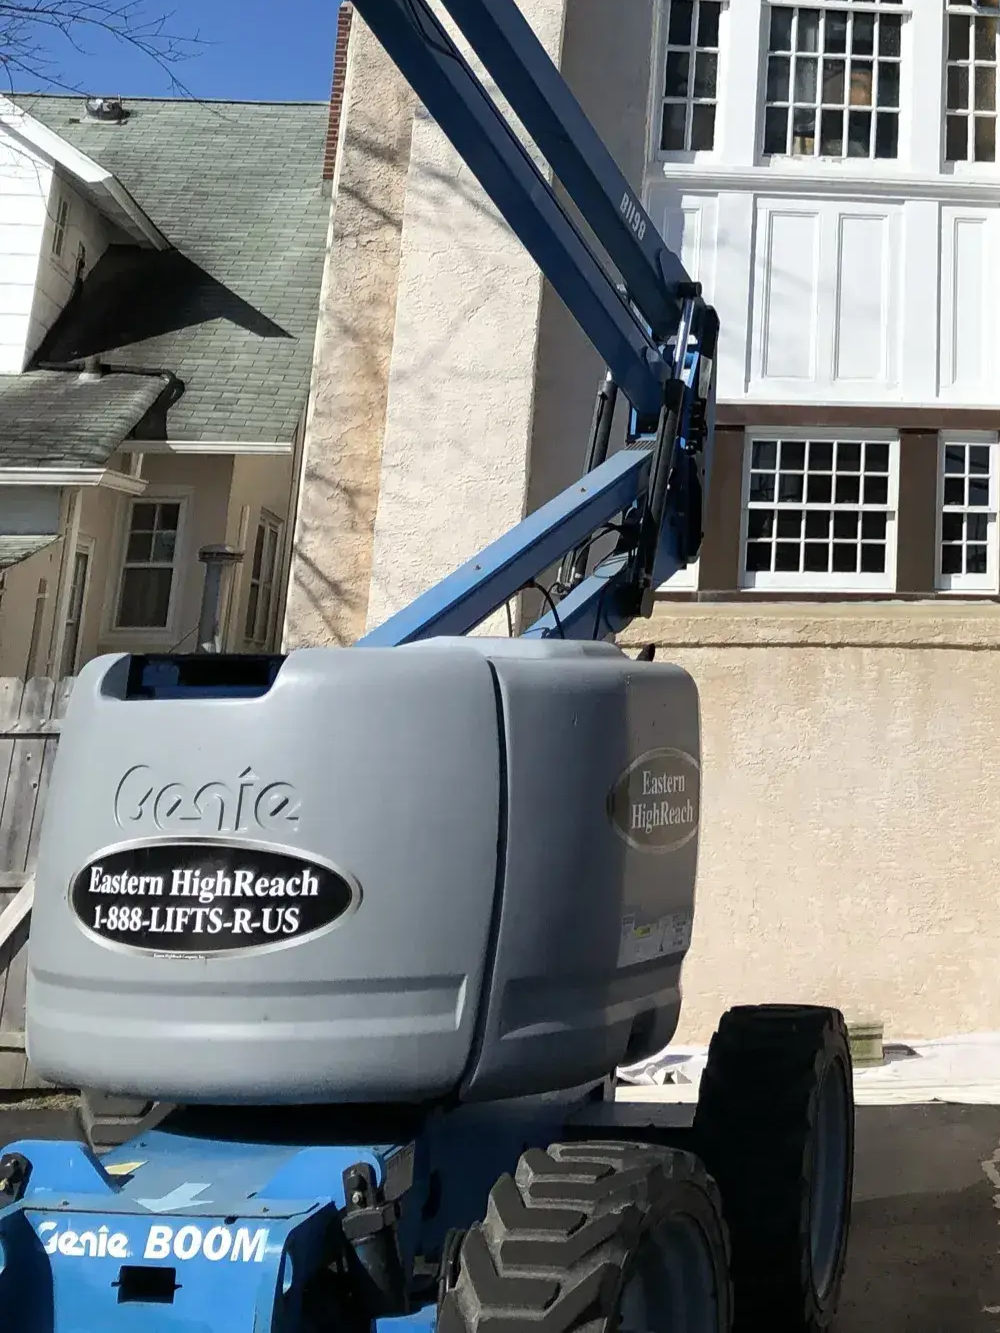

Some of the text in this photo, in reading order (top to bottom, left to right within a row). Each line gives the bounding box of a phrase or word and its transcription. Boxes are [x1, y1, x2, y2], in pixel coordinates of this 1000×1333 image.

[113, 763, 301, 833] Genie
[642, 770, 686, 795] Eastern
[631, 799, 694, 834] HighReach
[88, 866, 319, 903] Eastern HighReach
[92, 904, 300, 934] 1-888-LIFTS-R-US
[38, 1221, 270, 1263] Genie BOOM
